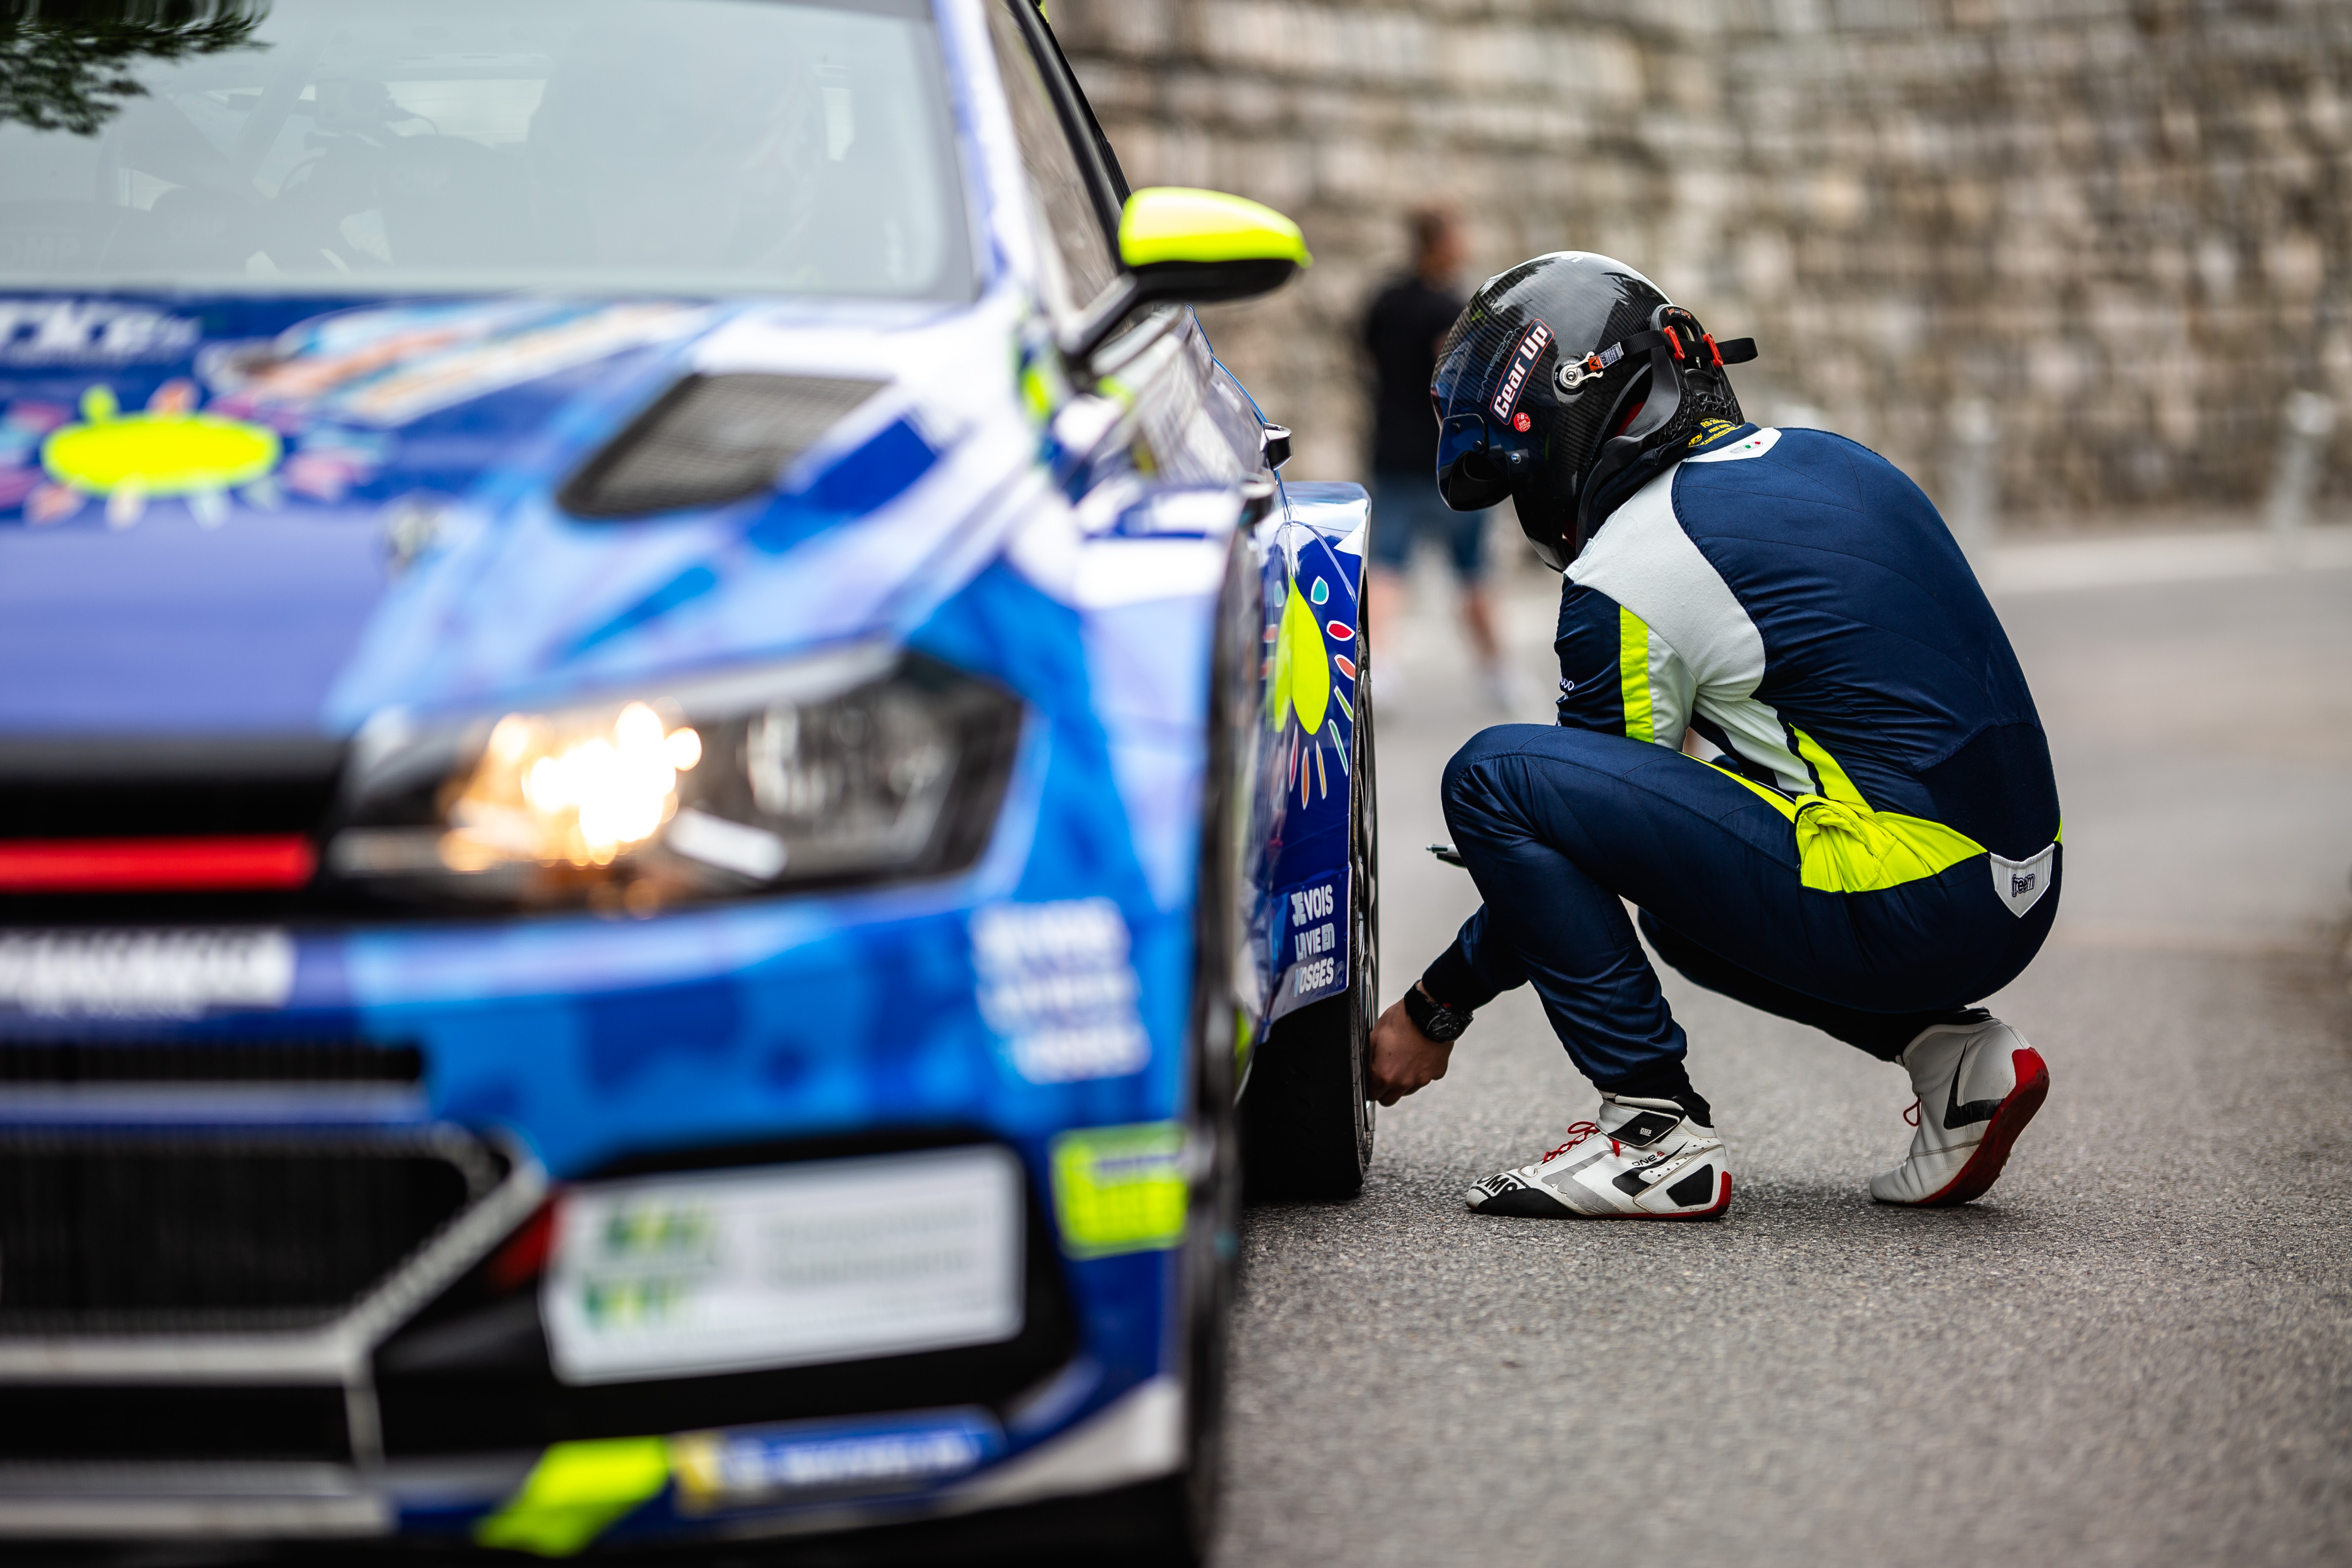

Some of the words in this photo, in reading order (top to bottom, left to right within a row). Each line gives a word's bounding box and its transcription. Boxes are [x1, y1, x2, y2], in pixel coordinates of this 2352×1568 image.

[1494, 356, 1526, 419] Gear
[1519, 325, 1549, 361] Up
[1291, 891, 1307, 927] JE
[1304, 884, 1333, 921] VOIS
[1295, 932, 1307, 962] LA
[1305, 927, 1321, 956] VIE
[1294, 956, 1334, 998] VOSGES
